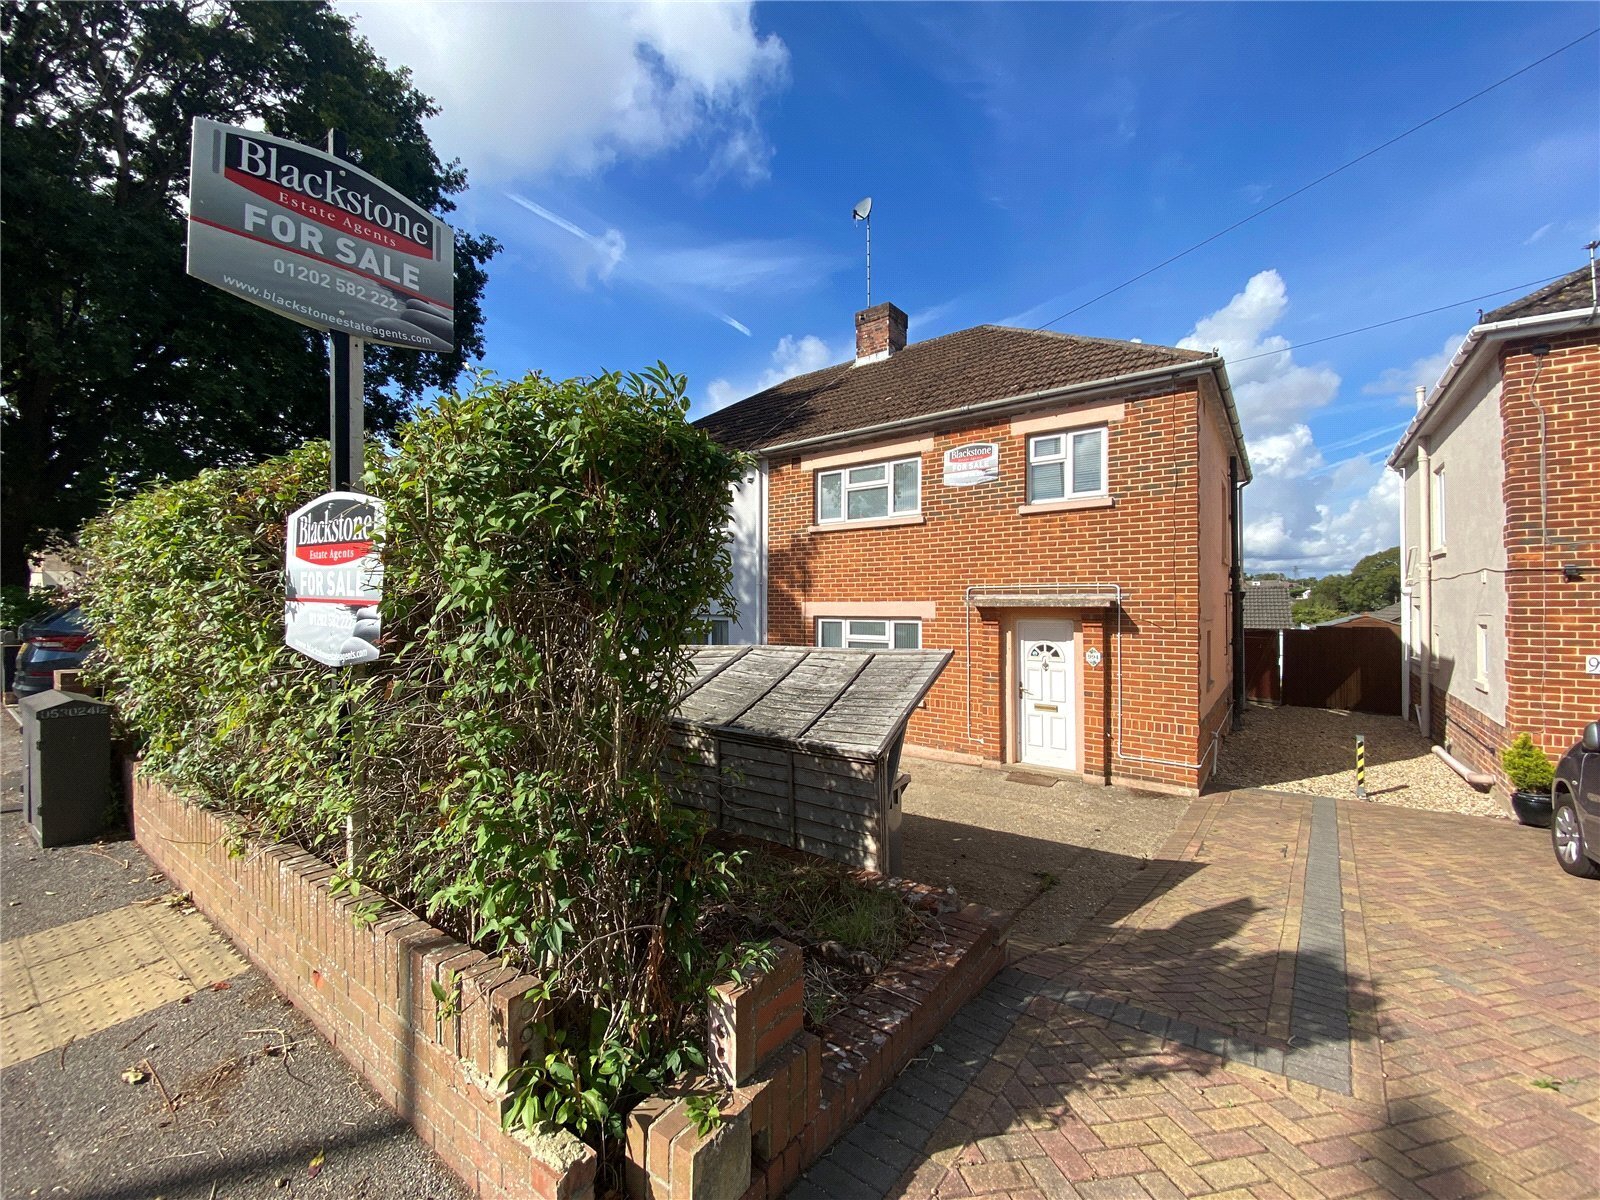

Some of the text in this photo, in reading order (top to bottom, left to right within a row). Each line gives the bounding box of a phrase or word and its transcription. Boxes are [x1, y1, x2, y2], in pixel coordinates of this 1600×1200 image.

[238, 137, 428, 245] Blackstone
[279, 191, 396, 247] Estate Agents
[244, 203, 420, 291] FOR SALE
[273, 259, 399, 311] 01202 582 222
[223, 275, 431, 344] www.blackstoneestateagents.com
[951, 447, 991, 460] Blackstone
[299, 509, 372, 545] Blackstone
[309, 549, 354, 561] Estate Agents
[300, 570, 324, 596] FOR
[1588, 656, 1600, 672] 9
